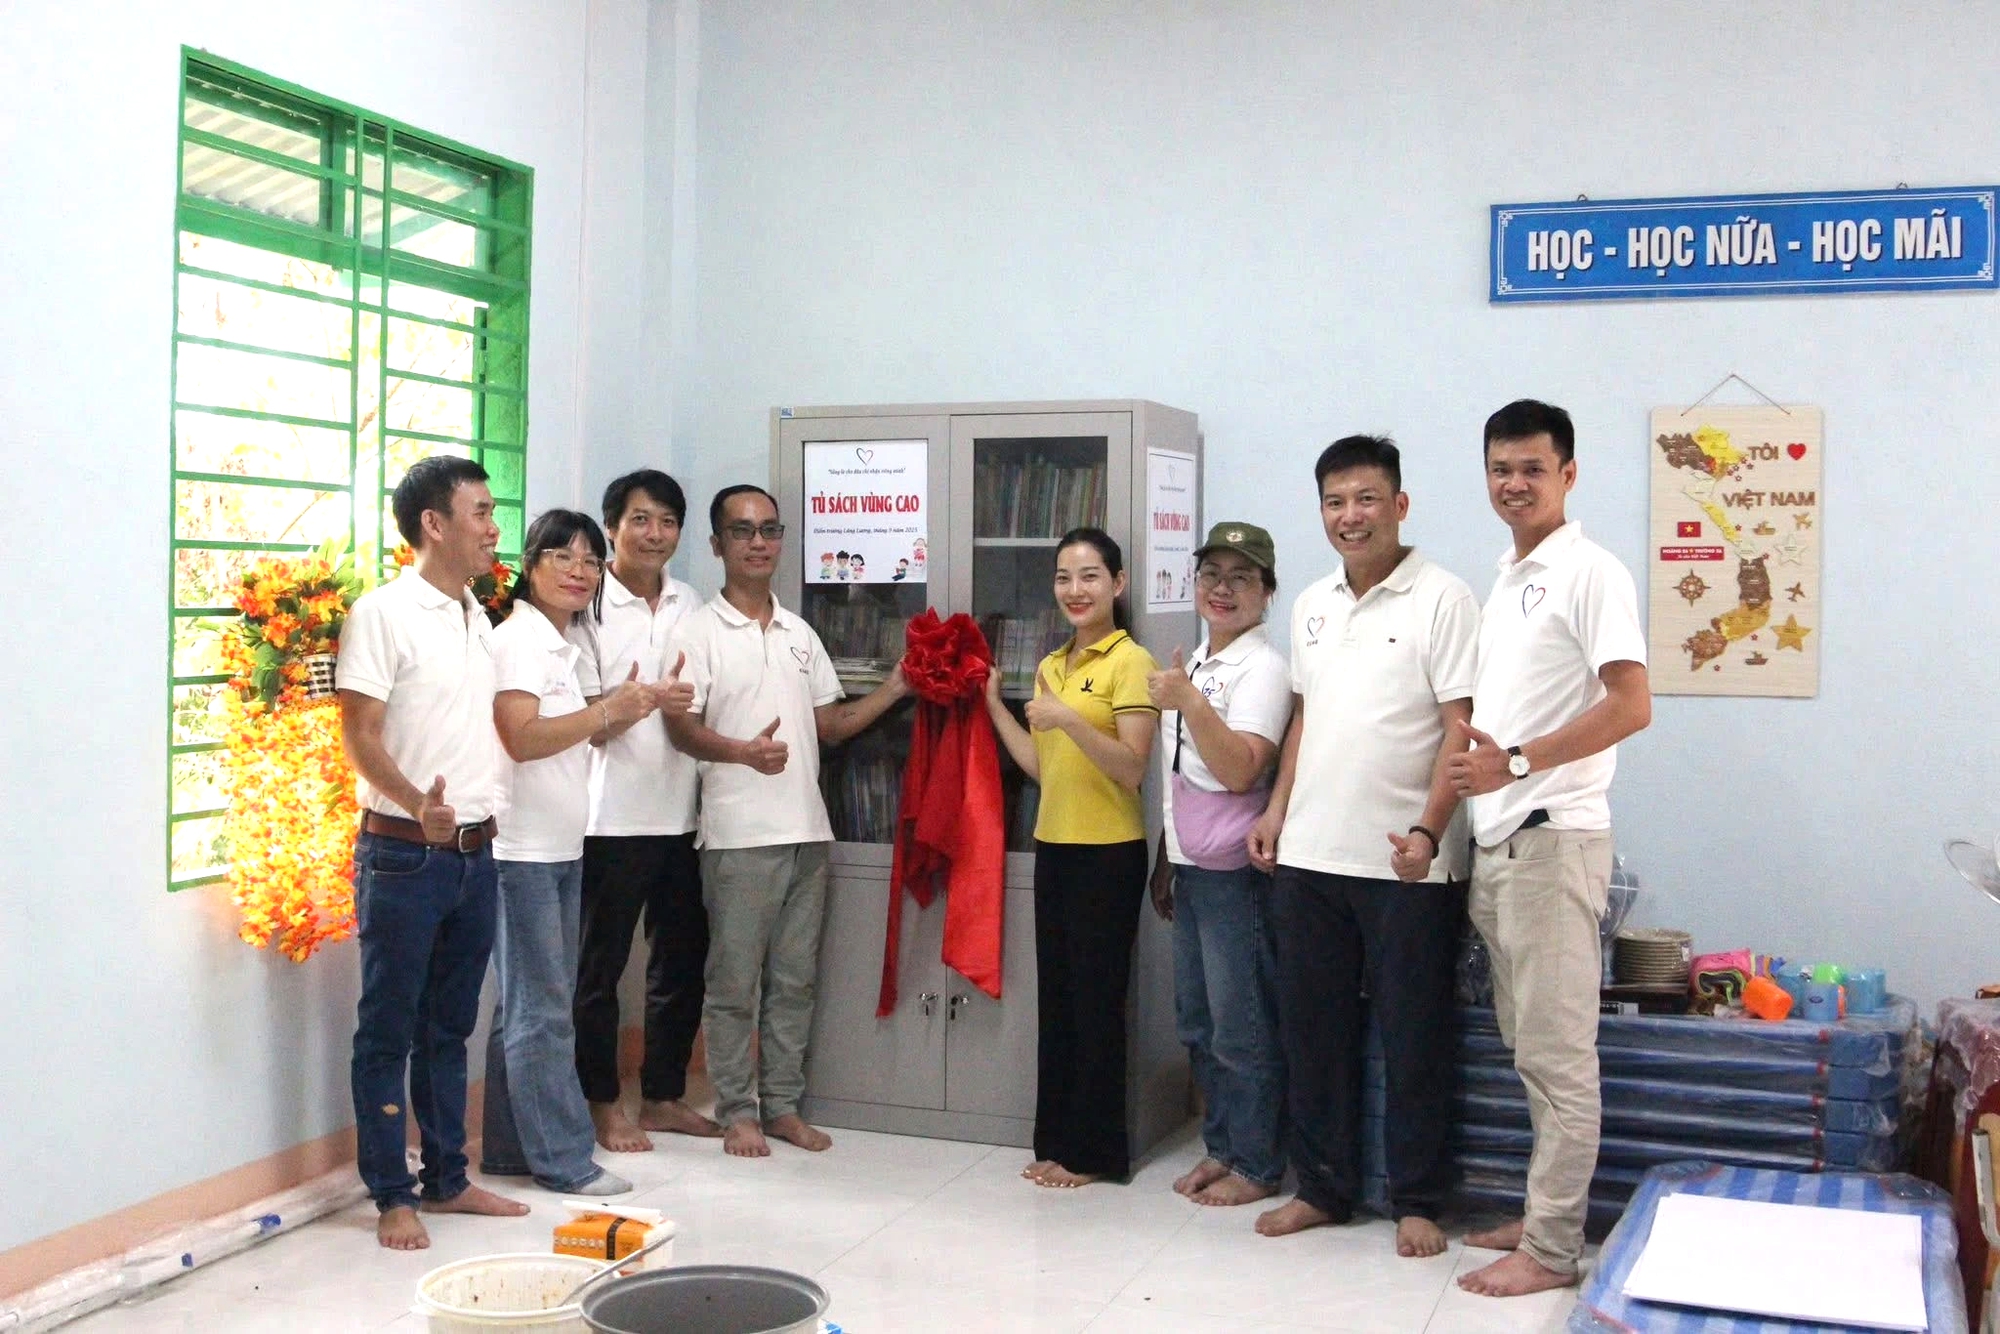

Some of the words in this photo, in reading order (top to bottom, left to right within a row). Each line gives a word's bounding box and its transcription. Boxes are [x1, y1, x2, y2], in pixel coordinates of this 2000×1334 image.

[1528, 229, 1593, 280] HỌC
[1628, 225, 1695, 277] HỌC
[1706, 215, 1777, 267] NỮA
[1812, 218, 1882, 272] HỌC
[1894, 208, 1962, 260] MÃI
[1747, 442, 1779, 461] TÔI
[811, 490, 826, 514] TỦ
[828, 492, 858, 514] SÁCH
[860, 491, 892, 513] VÙNG
[895, 494, 920, 513] CAO
[1722, 489, 1766, 511] VIỆT
[1770, 491, 1815, 507] NAM
